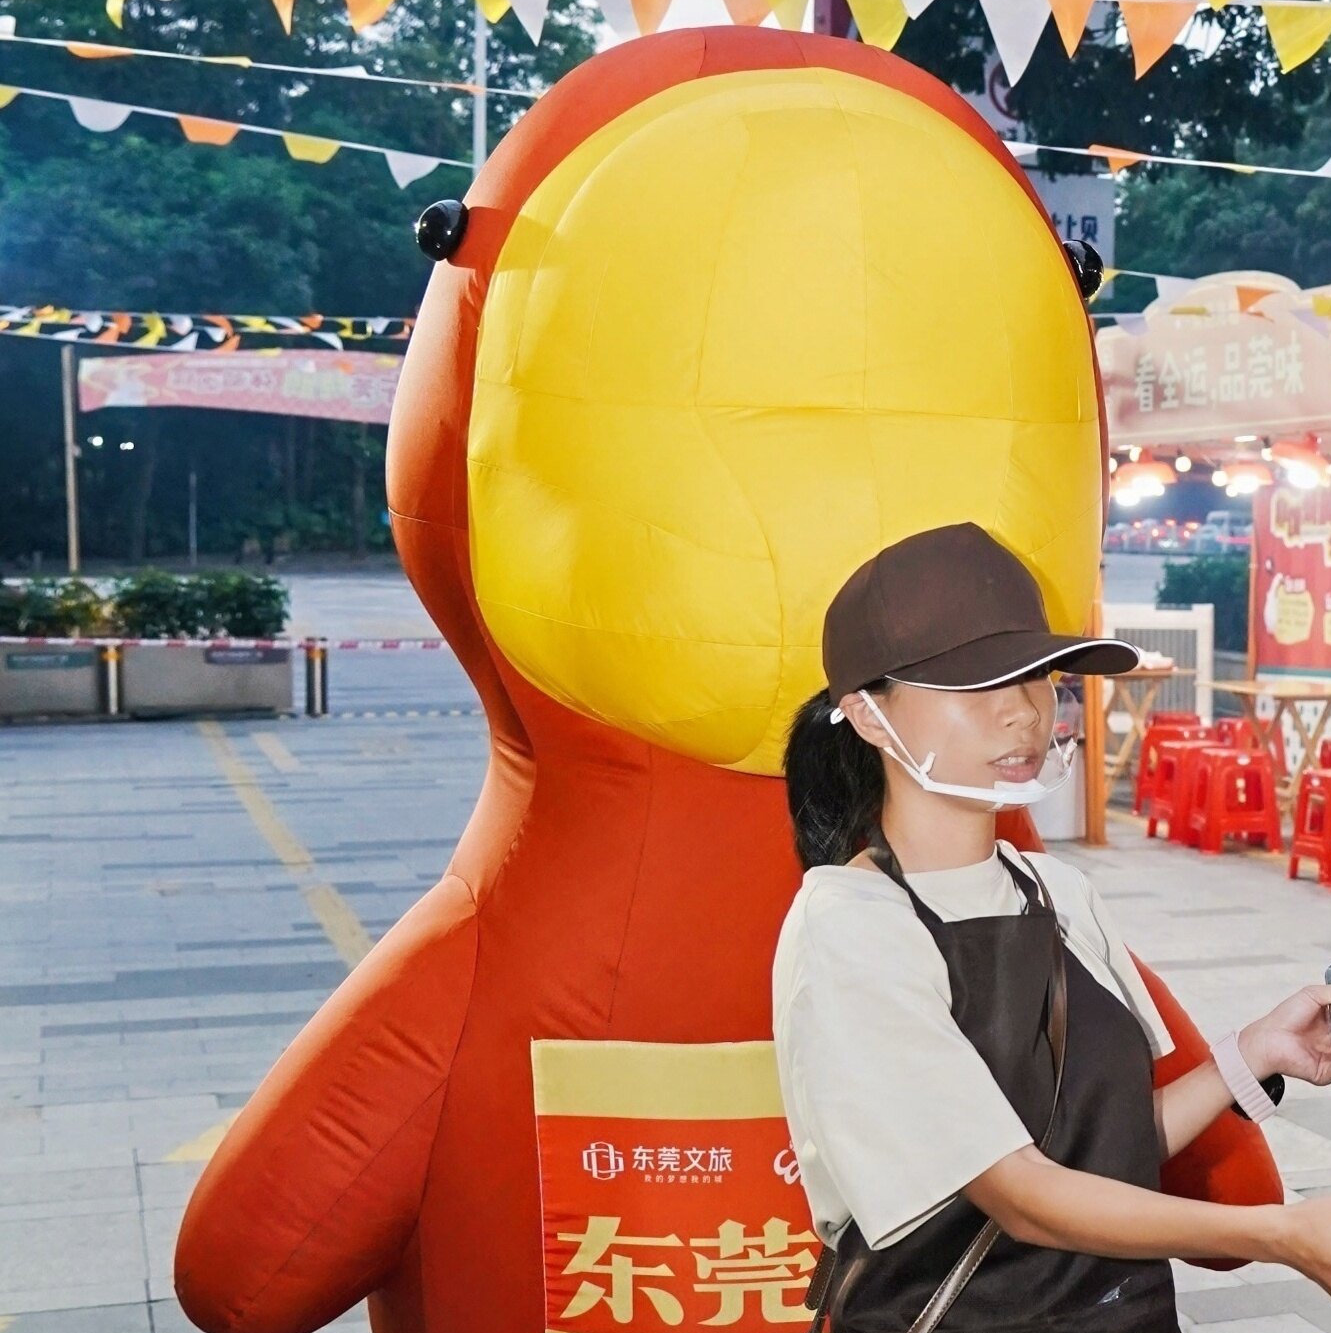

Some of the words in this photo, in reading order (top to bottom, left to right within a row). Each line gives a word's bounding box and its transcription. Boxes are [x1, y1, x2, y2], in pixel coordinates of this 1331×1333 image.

[631, 1145, 733, 1173] 东莞文旅
[556, 1215, 820, 1326] 东莞
